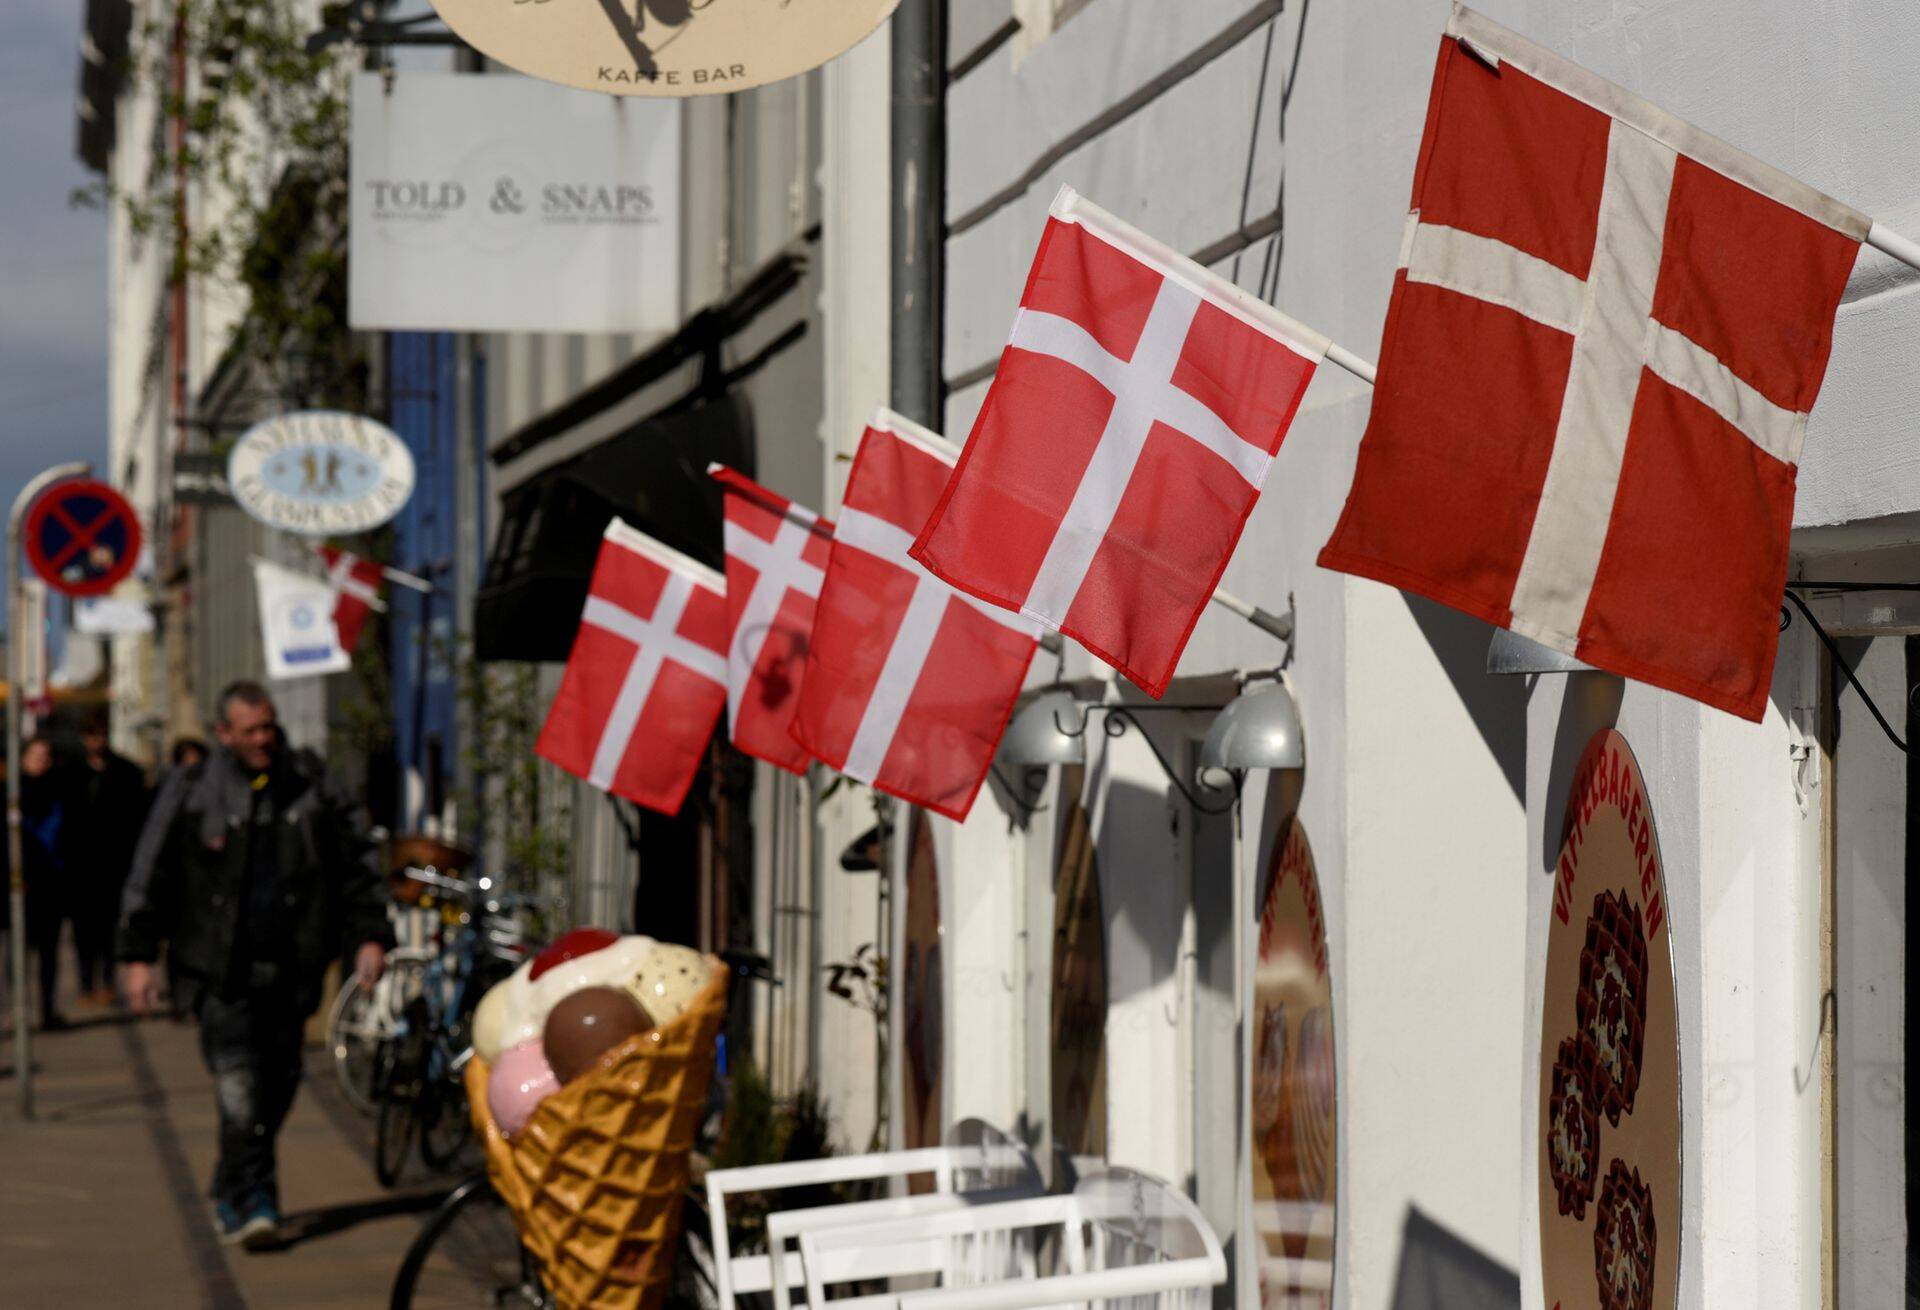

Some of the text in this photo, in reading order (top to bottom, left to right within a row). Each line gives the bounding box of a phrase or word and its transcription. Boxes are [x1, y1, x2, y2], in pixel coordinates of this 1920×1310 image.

[598, 63, 746, 85] KAFFE BAR
[366, 176, 655, 214] TOLD & SNAPS
[1556, 745, 1663, 942] VAFFELBAGEREN
